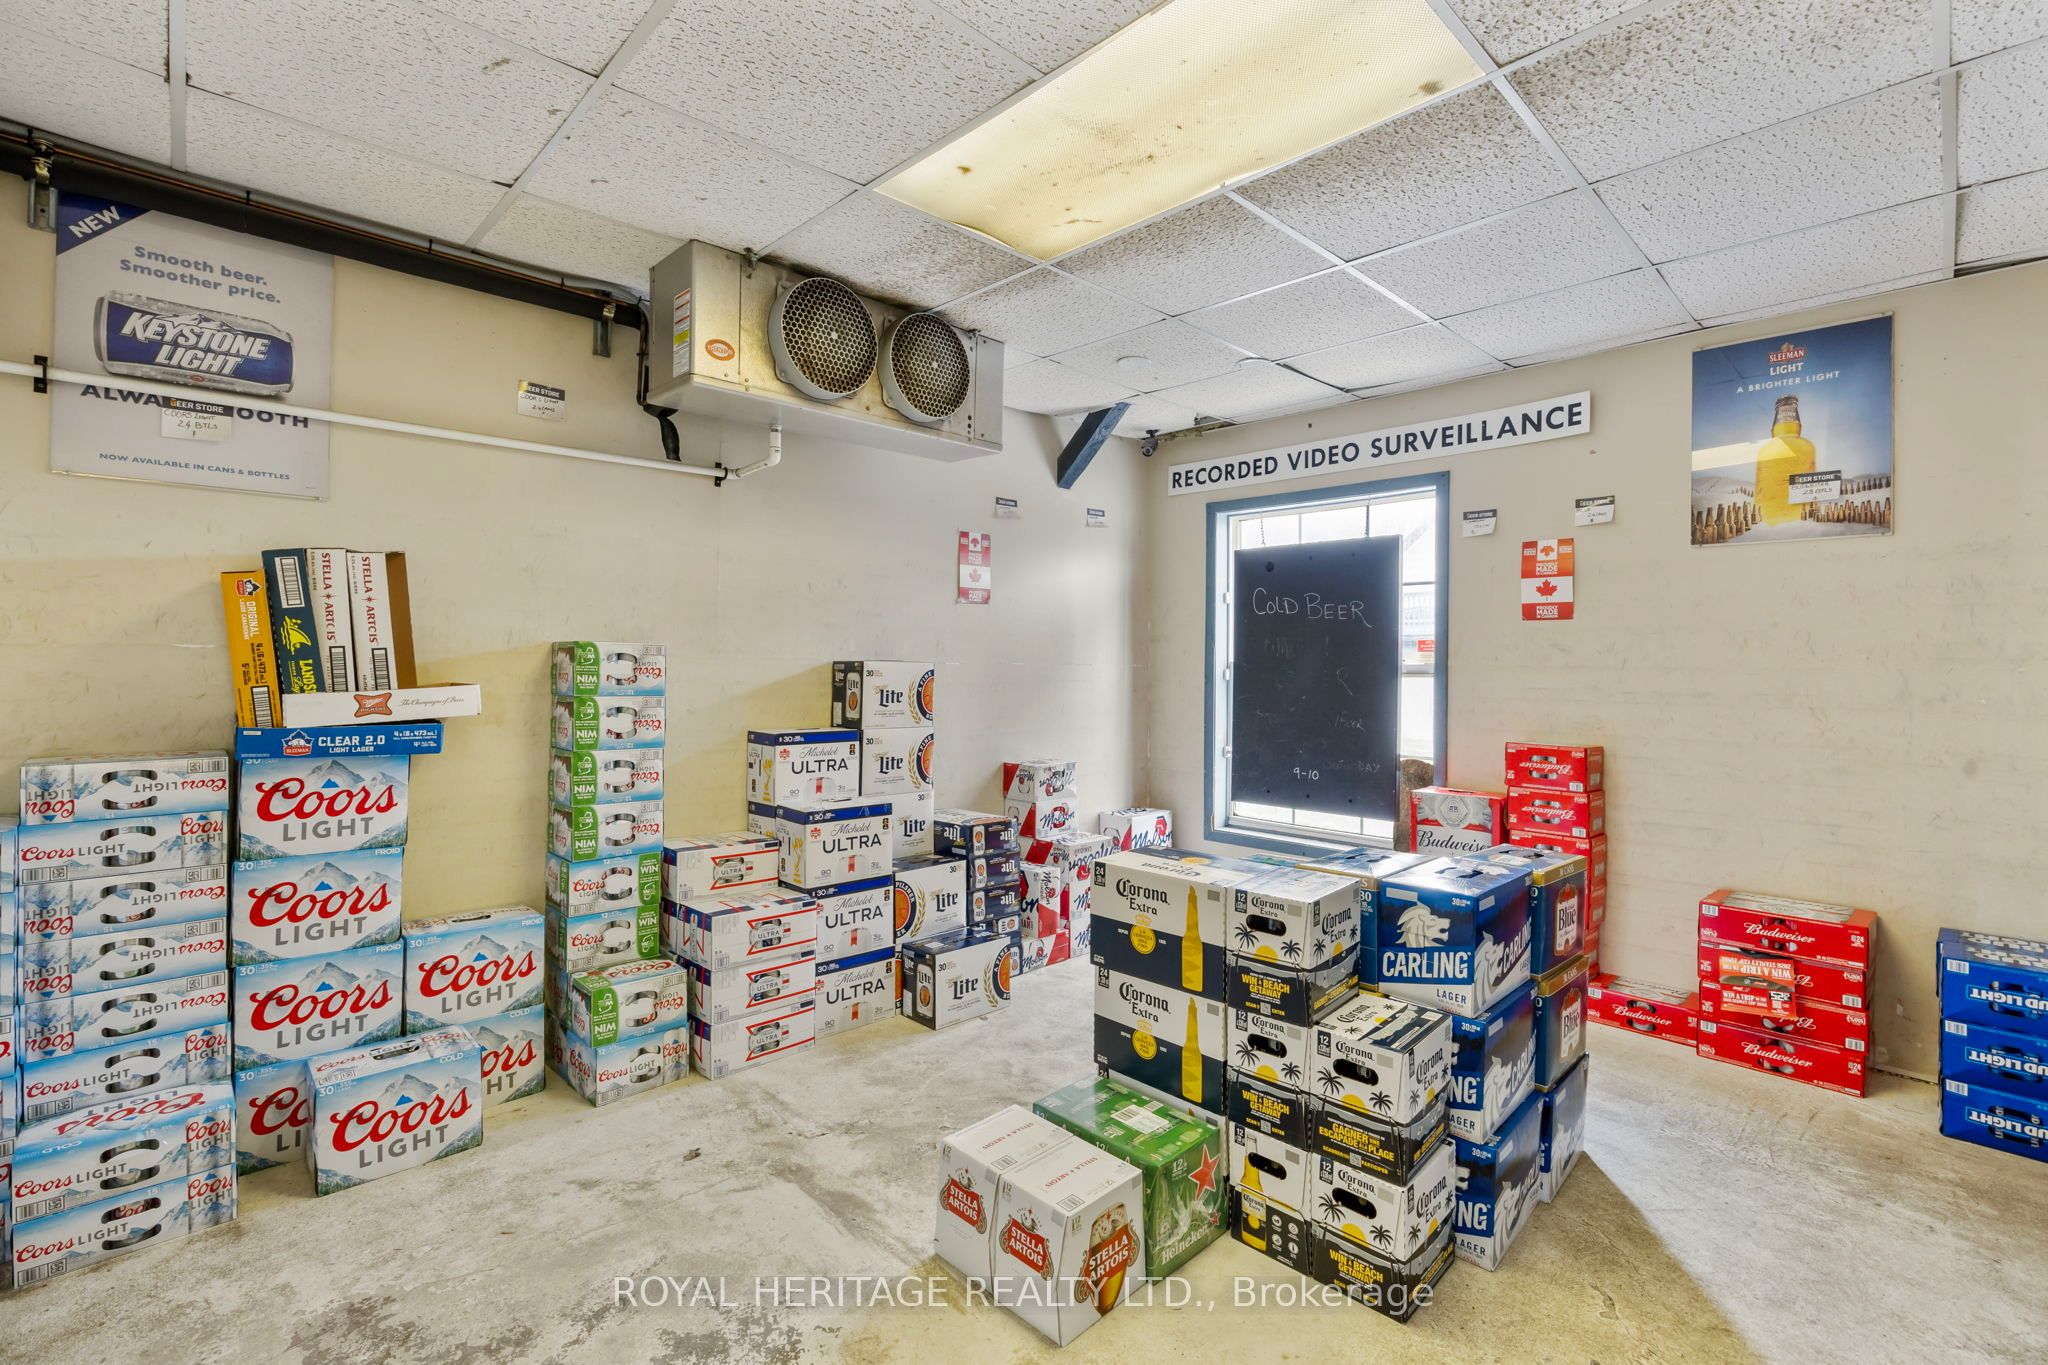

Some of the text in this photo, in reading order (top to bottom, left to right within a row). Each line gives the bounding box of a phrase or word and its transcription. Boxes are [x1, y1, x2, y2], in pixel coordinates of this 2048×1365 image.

[68, 206, 120, 239] NEW
[134, 246, 267, 285] Smooth beer.
[120, 259, 280, 303] Smoother price.
[120, 312, 271, 360] KEYSTONE
[155, 345, 242, 376] LIGHT
[1770, 350, 1804, 362] SLEEMAN
[1770, 362, 1804, 375] LIGHT
[1749, 378, 1801, 392] BRIGHTER
[1806, 371, 1840, 382] LIGHT
[81, 385, 309, 428] ALWA OOTH
[196, 404, 224, 413] STORE
[177, 420, 191, 429] 24
[1172, 402, 1582, 489] RECORDED VIDEO SURVEILLANCE
[99, 453, 128, 461] NOW
[132, 457, 190, 469] AVAILABLE
[208, 465, 235, 474] CANS
[248, 470, 290, 479] BOTTLES
[322, 553, 333, 590] STELLA
[361, 556, 373, 593] STELLA
[247, 602, 259, 637] ORIGINAL
[1304, 593, 1372, 628] BEER
[879, 689, 903, 707] Lite
[318, 737, 360, 747] CLEAR
[365, 735, 385, 745] 2.0
[800, 747, 838, 758] Michelob
[792, 758, 848, 774] ULTRA
[879, 755, 903, 774] Lite
[1293, 767, 1319, 780] 9-10
[1519, 761, 1573, 775] Budweiser
[255, 777, 398, 822] Coors
[282, 816, 374, 842] LIGHT
[831, 823, 871, 836] Michelob
[903, 818, 925, 837] Lite
[375, 847, 401, 856] FROID
[822, 834, 881, 853] ULTRA
[238, 862, 253, 871] 30
[641, 865, 658, 873] WIN
[1116, 878, 1168, 903] Corona
[1237, 892, 1246, 900] 12
[248, 881, 391, 927] Coors
[833, 896, 873, 910] Michelob
[936, 892, 958, 912] Lite
[1129, 898, 1157, 915] Extra
[1252, 896, 1285, 911] Corona
[1259, 907, 1278, 917] Extra
[639, 917, 657, 925] WIN
[825, 906, 883, 928] ULTRA
[1559, 909, 1577, 931] Blue
[274, 916, 367, 946] LIGHT
[1330, 929, 1346, 943] Extra
[1744, 922, 1815, 943] Budweiser
[376, 943, 401, 953] FROID
[409, 939, 422, 948] 30
[824, 944, 834, 952] 90
[240, 966, 255, 975] 30
[419, 950, 537, 997] Coors
[1099, 968, 1108, 977] 24
[1383, 951, 1469, 979] CARLING
[1740, 965, 1762, 974] TRIP
[1772, 969, 1791, 980] WIN
[835, 969, 874, 985] Michelob
[1242, 974, 1290, 993] WIN BEACH
[441, 982, 517, 1014] LIGHT
[826, 978, 885, 1005] ULTRA
[953, 977, 979, 1000] Lite
[1119, 981, 1169, 1012] Corona
[1250, 985, 1281, 999] GETAWAY
[1436, 989, 1467, 1004] LAGER
[1970, 988, 2023, 1007] LIGHT
[250, 979, 393, 1031] Coors
[510, 1008, 530, 1018] COLD
[1131, 1003, 1159, 1023] Extra
[1237, 1011, 1246, 1019] 12
[1252, 1016, 1285, 1032] Corona
[1564, 1013, 1579, 1035] Blue
[1613, 1005, 1672, 1026] Budweiser
[277, 1014, 368, 1049] LIGHT
[1319, 1033, 1330, 1045] 12
[440, 1052, 464, 1064] COLD
[1335, 1040, 1374, 1061] Corona
[1741, 1042, 1813, 1068] Budweiser
[1969, 1050, 2022, 1070] LIGHT
[239, 1072, 255, 1081] 30
[319, 1086, 334, 1097] 30
[1242, 1090, 1289, 1115] WIN BEACH
[1250, 1102, 1282, 1119] GETAWAY
[330, 1086, 472, 1152] Coors
[1970, 1109, 2022, 1133] LIGHT
[1332, 1123, 1369, 1141] GAGNER
[359, 1125, 448, 1168] LIGHT
[1319, 1127, 1394, 1161] ESCAPADE PLAGE
[1361, 1160, 1388, 1174] PARTICIPER
[948, 1197, 978, 1220] ARTOIS
[950, 1186, 978, 1211] STELLA
[1011, 1229, 1044, 1253] STELLA
[1161, 1224, 1210, 1265] Heineken
[1009, 1237, 1043, 1266] ARTOIS
[1090, 1236, 1128, 1270] STELLA
[1090, 1250, 1128, 1284] ARTOIS
[1339, 1263, 1374, 1285] GETAWAY
[1354, 1262, 1383, 1282] BEACH
